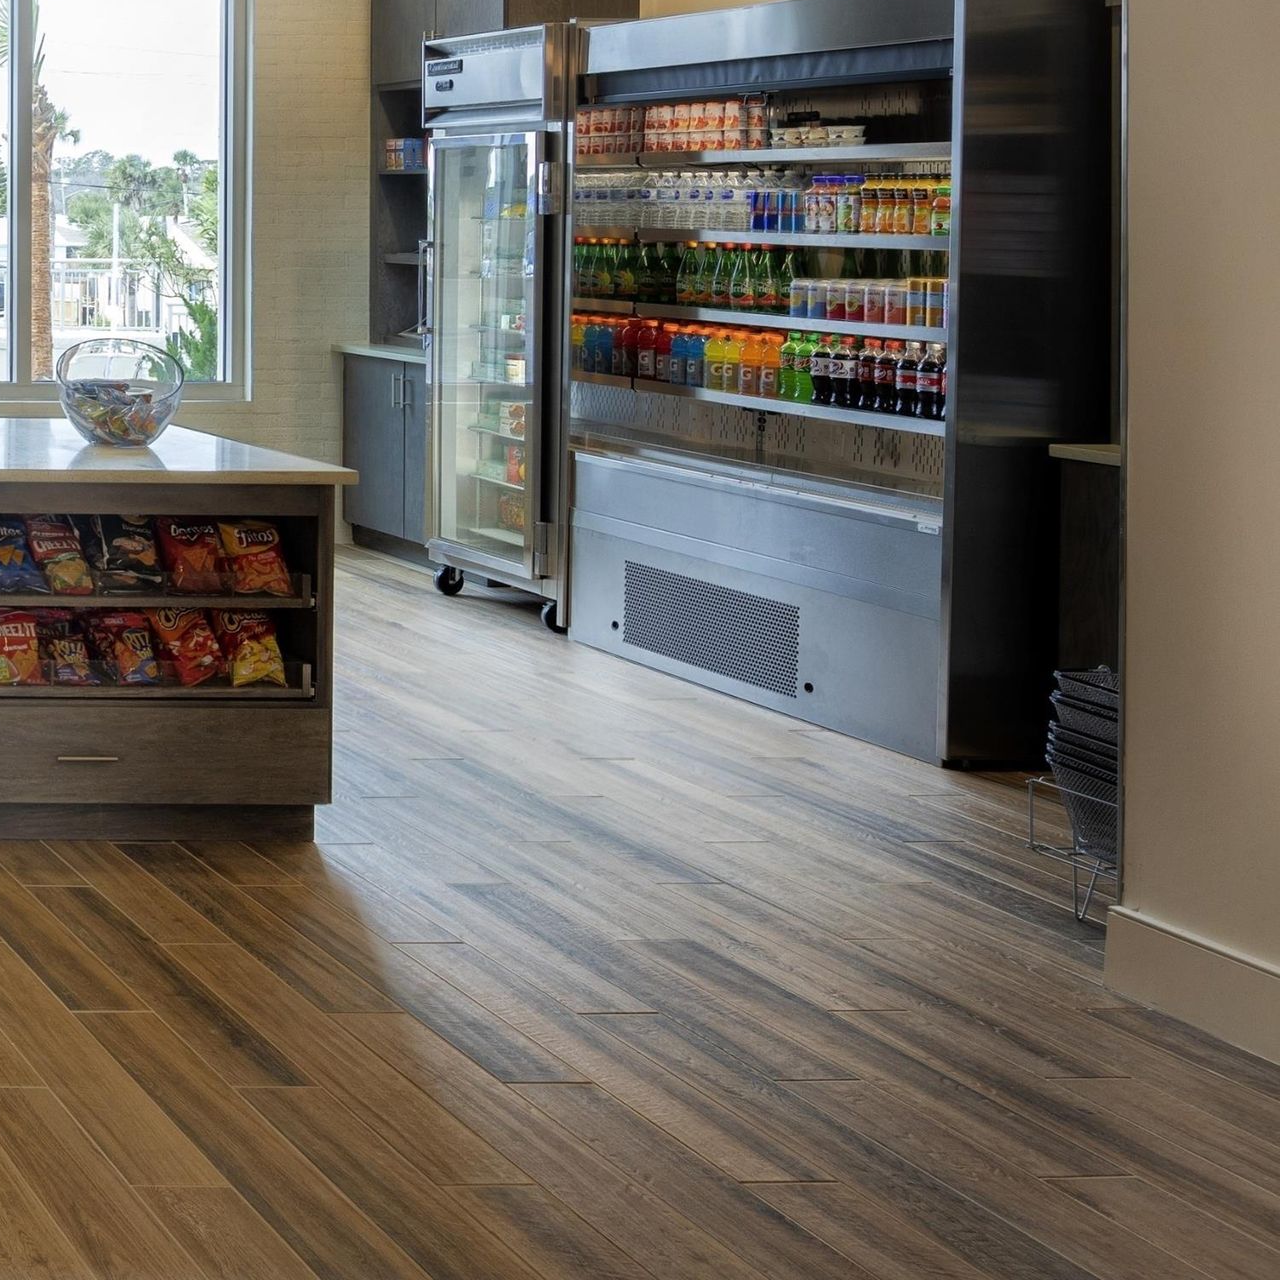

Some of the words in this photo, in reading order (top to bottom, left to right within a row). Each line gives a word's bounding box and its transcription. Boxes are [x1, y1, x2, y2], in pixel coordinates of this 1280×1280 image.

[639, 352, 649, 363] G
[687, 361, 695, 372] G
[711, 364, 722, 375] G
[723, 365, 732, 376] G
[741, 368, 751, 380] G
[763, 369, 773, 380] G
[170, 524, 214, 536] Doritos
[234, 528, 274, 548] Fritos
